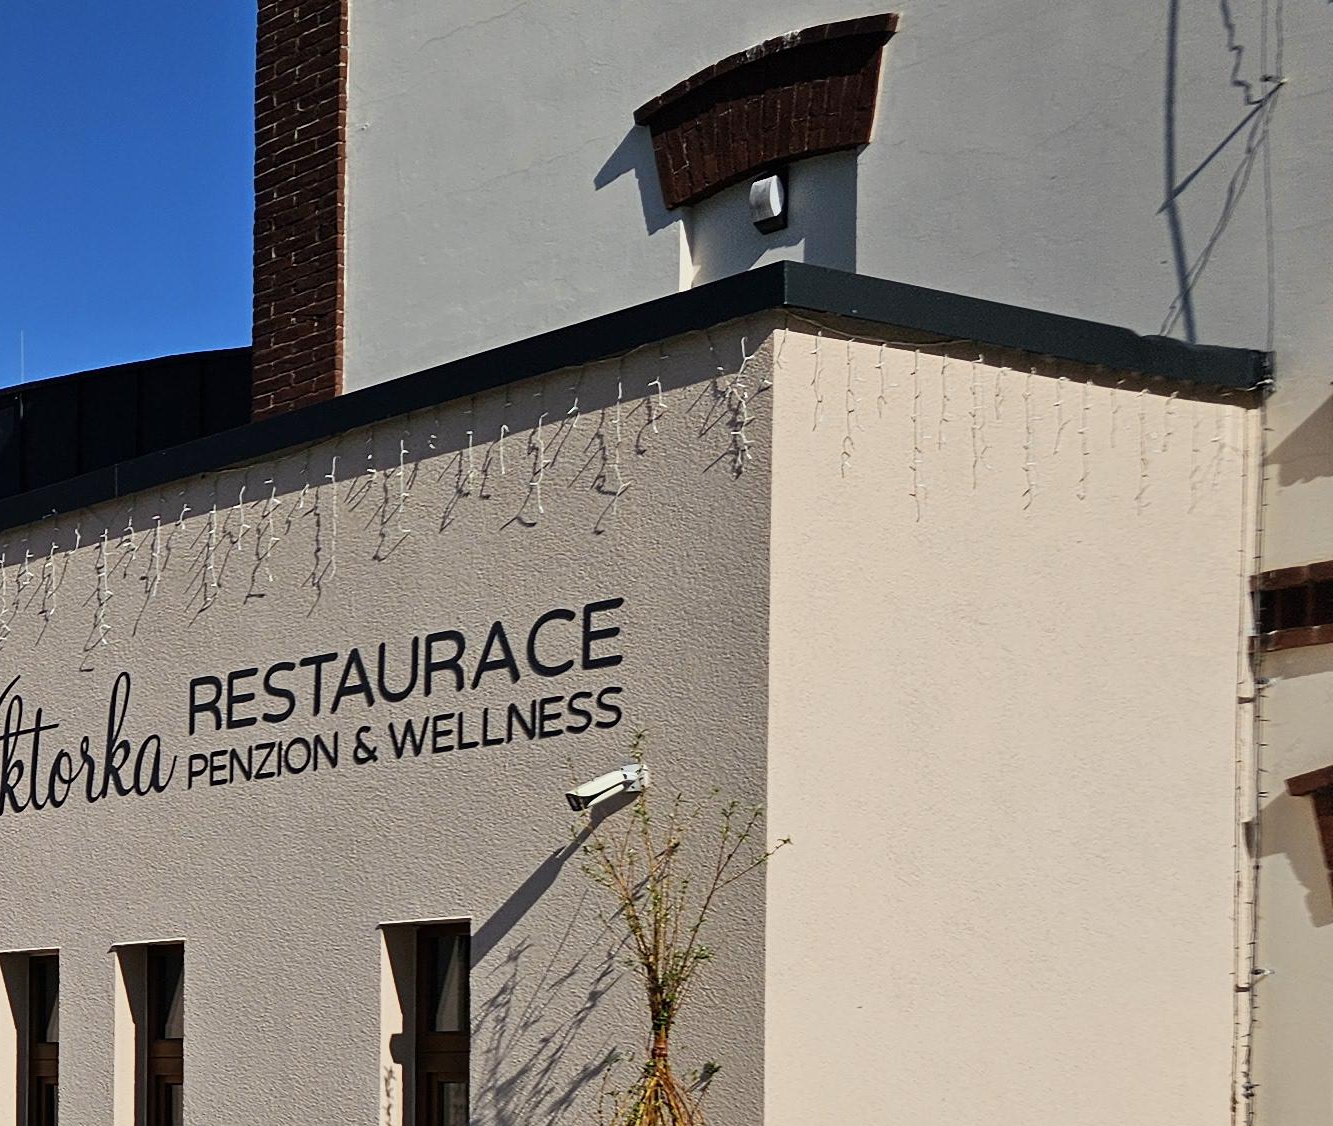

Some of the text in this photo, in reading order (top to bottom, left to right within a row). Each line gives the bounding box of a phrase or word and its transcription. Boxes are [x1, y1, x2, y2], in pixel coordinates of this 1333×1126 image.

[188, 597, 625, 736] RESTAURACE
[187, 686, 623, 790] PENZION & WELLNESS
